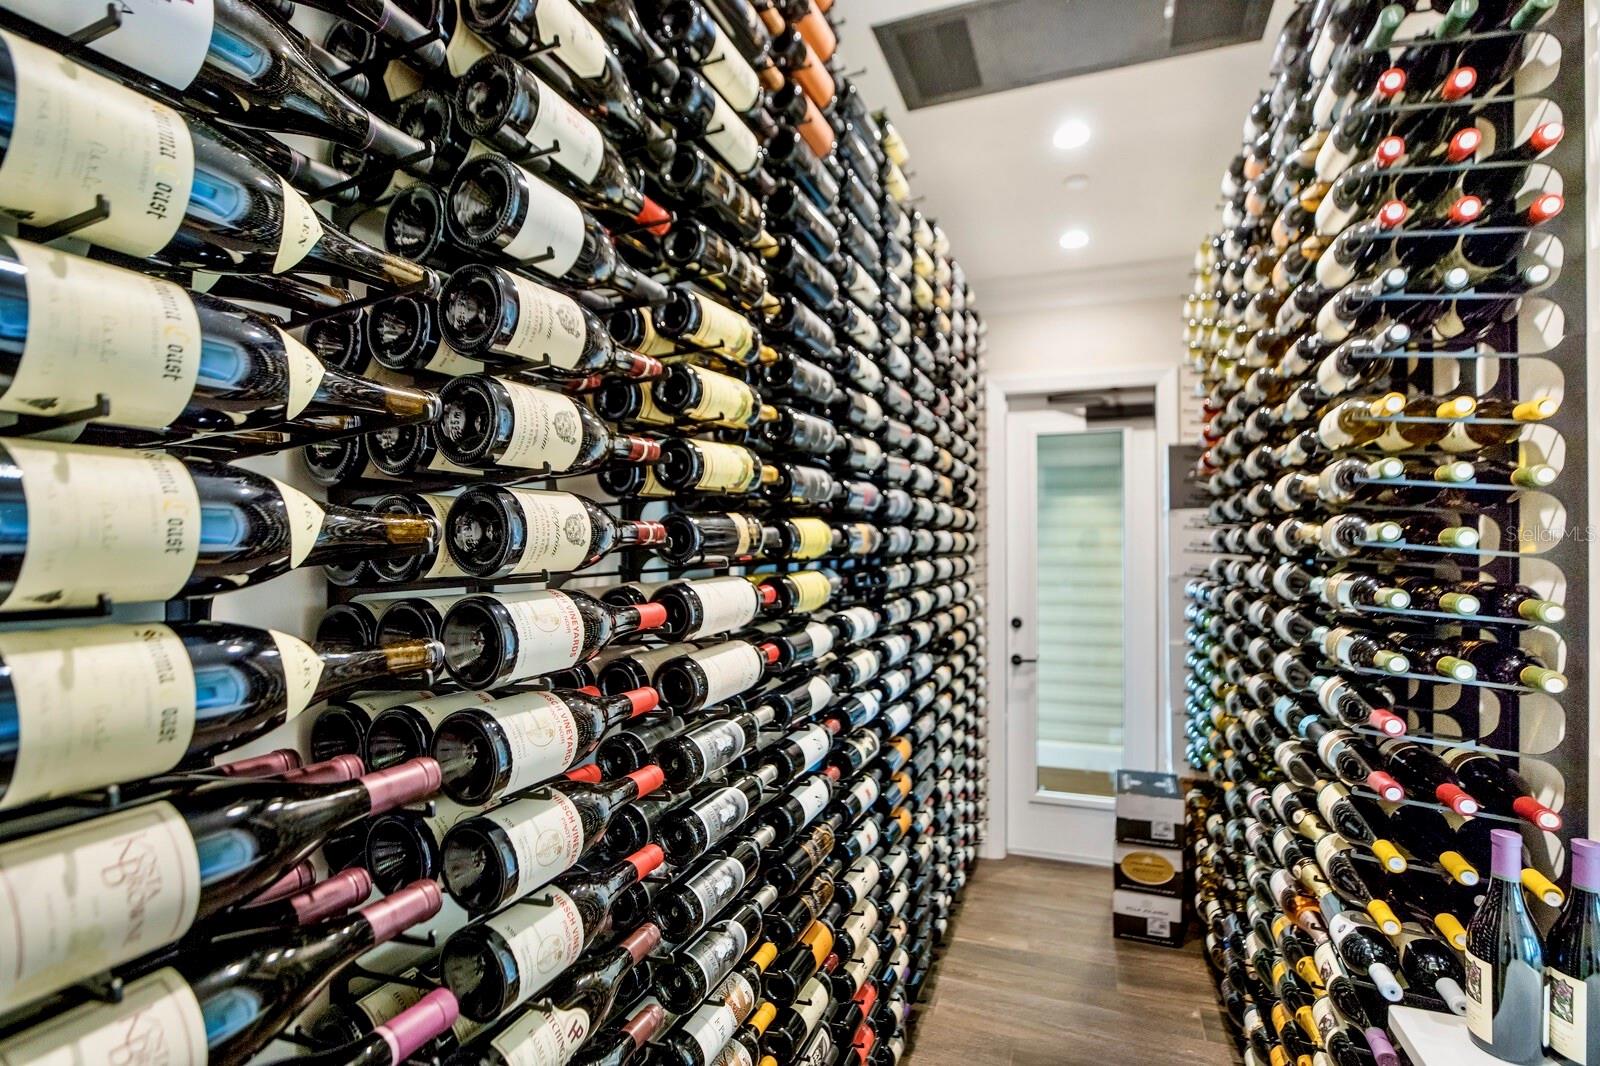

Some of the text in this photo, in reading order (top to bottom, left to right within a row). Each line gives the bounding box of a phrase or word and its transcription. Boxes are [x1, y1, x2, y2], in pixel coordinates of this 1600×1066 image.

[566, 605, 581, 658] VINEYARDS
[561, 712, 575, 767] VINEYARDS
[551, 793, 576, 825] HIRSCH
[553, 893, 577, 927] HIRSCH
